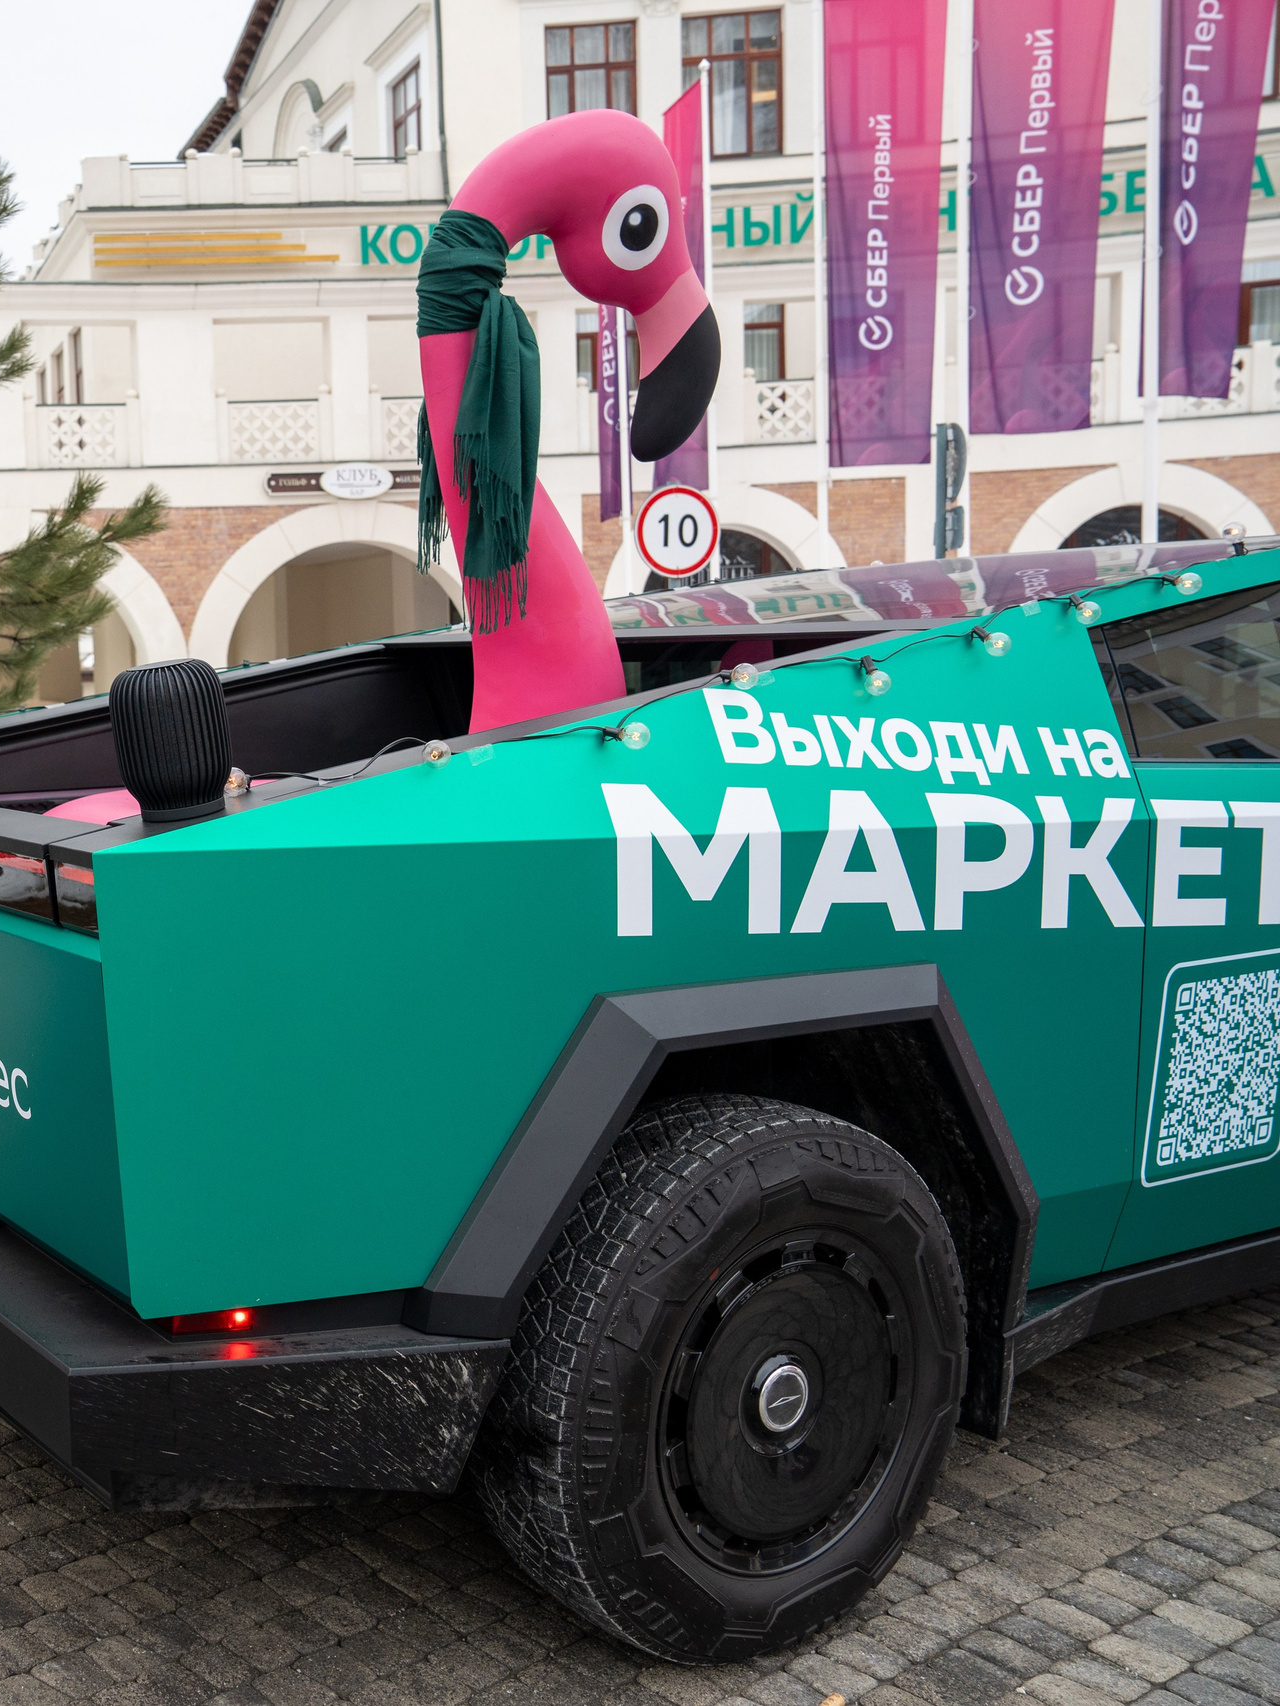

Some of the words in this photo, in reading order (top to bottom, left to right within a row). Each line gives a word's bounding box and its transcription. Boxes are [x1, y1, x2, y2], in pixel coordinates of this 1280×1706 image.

[1018, 28, 1056, 155] Первый
[1181, 82, 1205, 190] СБЕР
[868, 114, 894, 221] Первый
[1011, 164, 1044, 258] СБЕР
[866, 229, 888, 308] СБЕР
[336, 468, 378, 482] КЛУБ
[658, 514, 699, 548] 10
[703, 688, 1030, 786] Выходи
[1038, 727, 1131, 778] на
[600, 783, 1280, 937] МАРКЕТ
